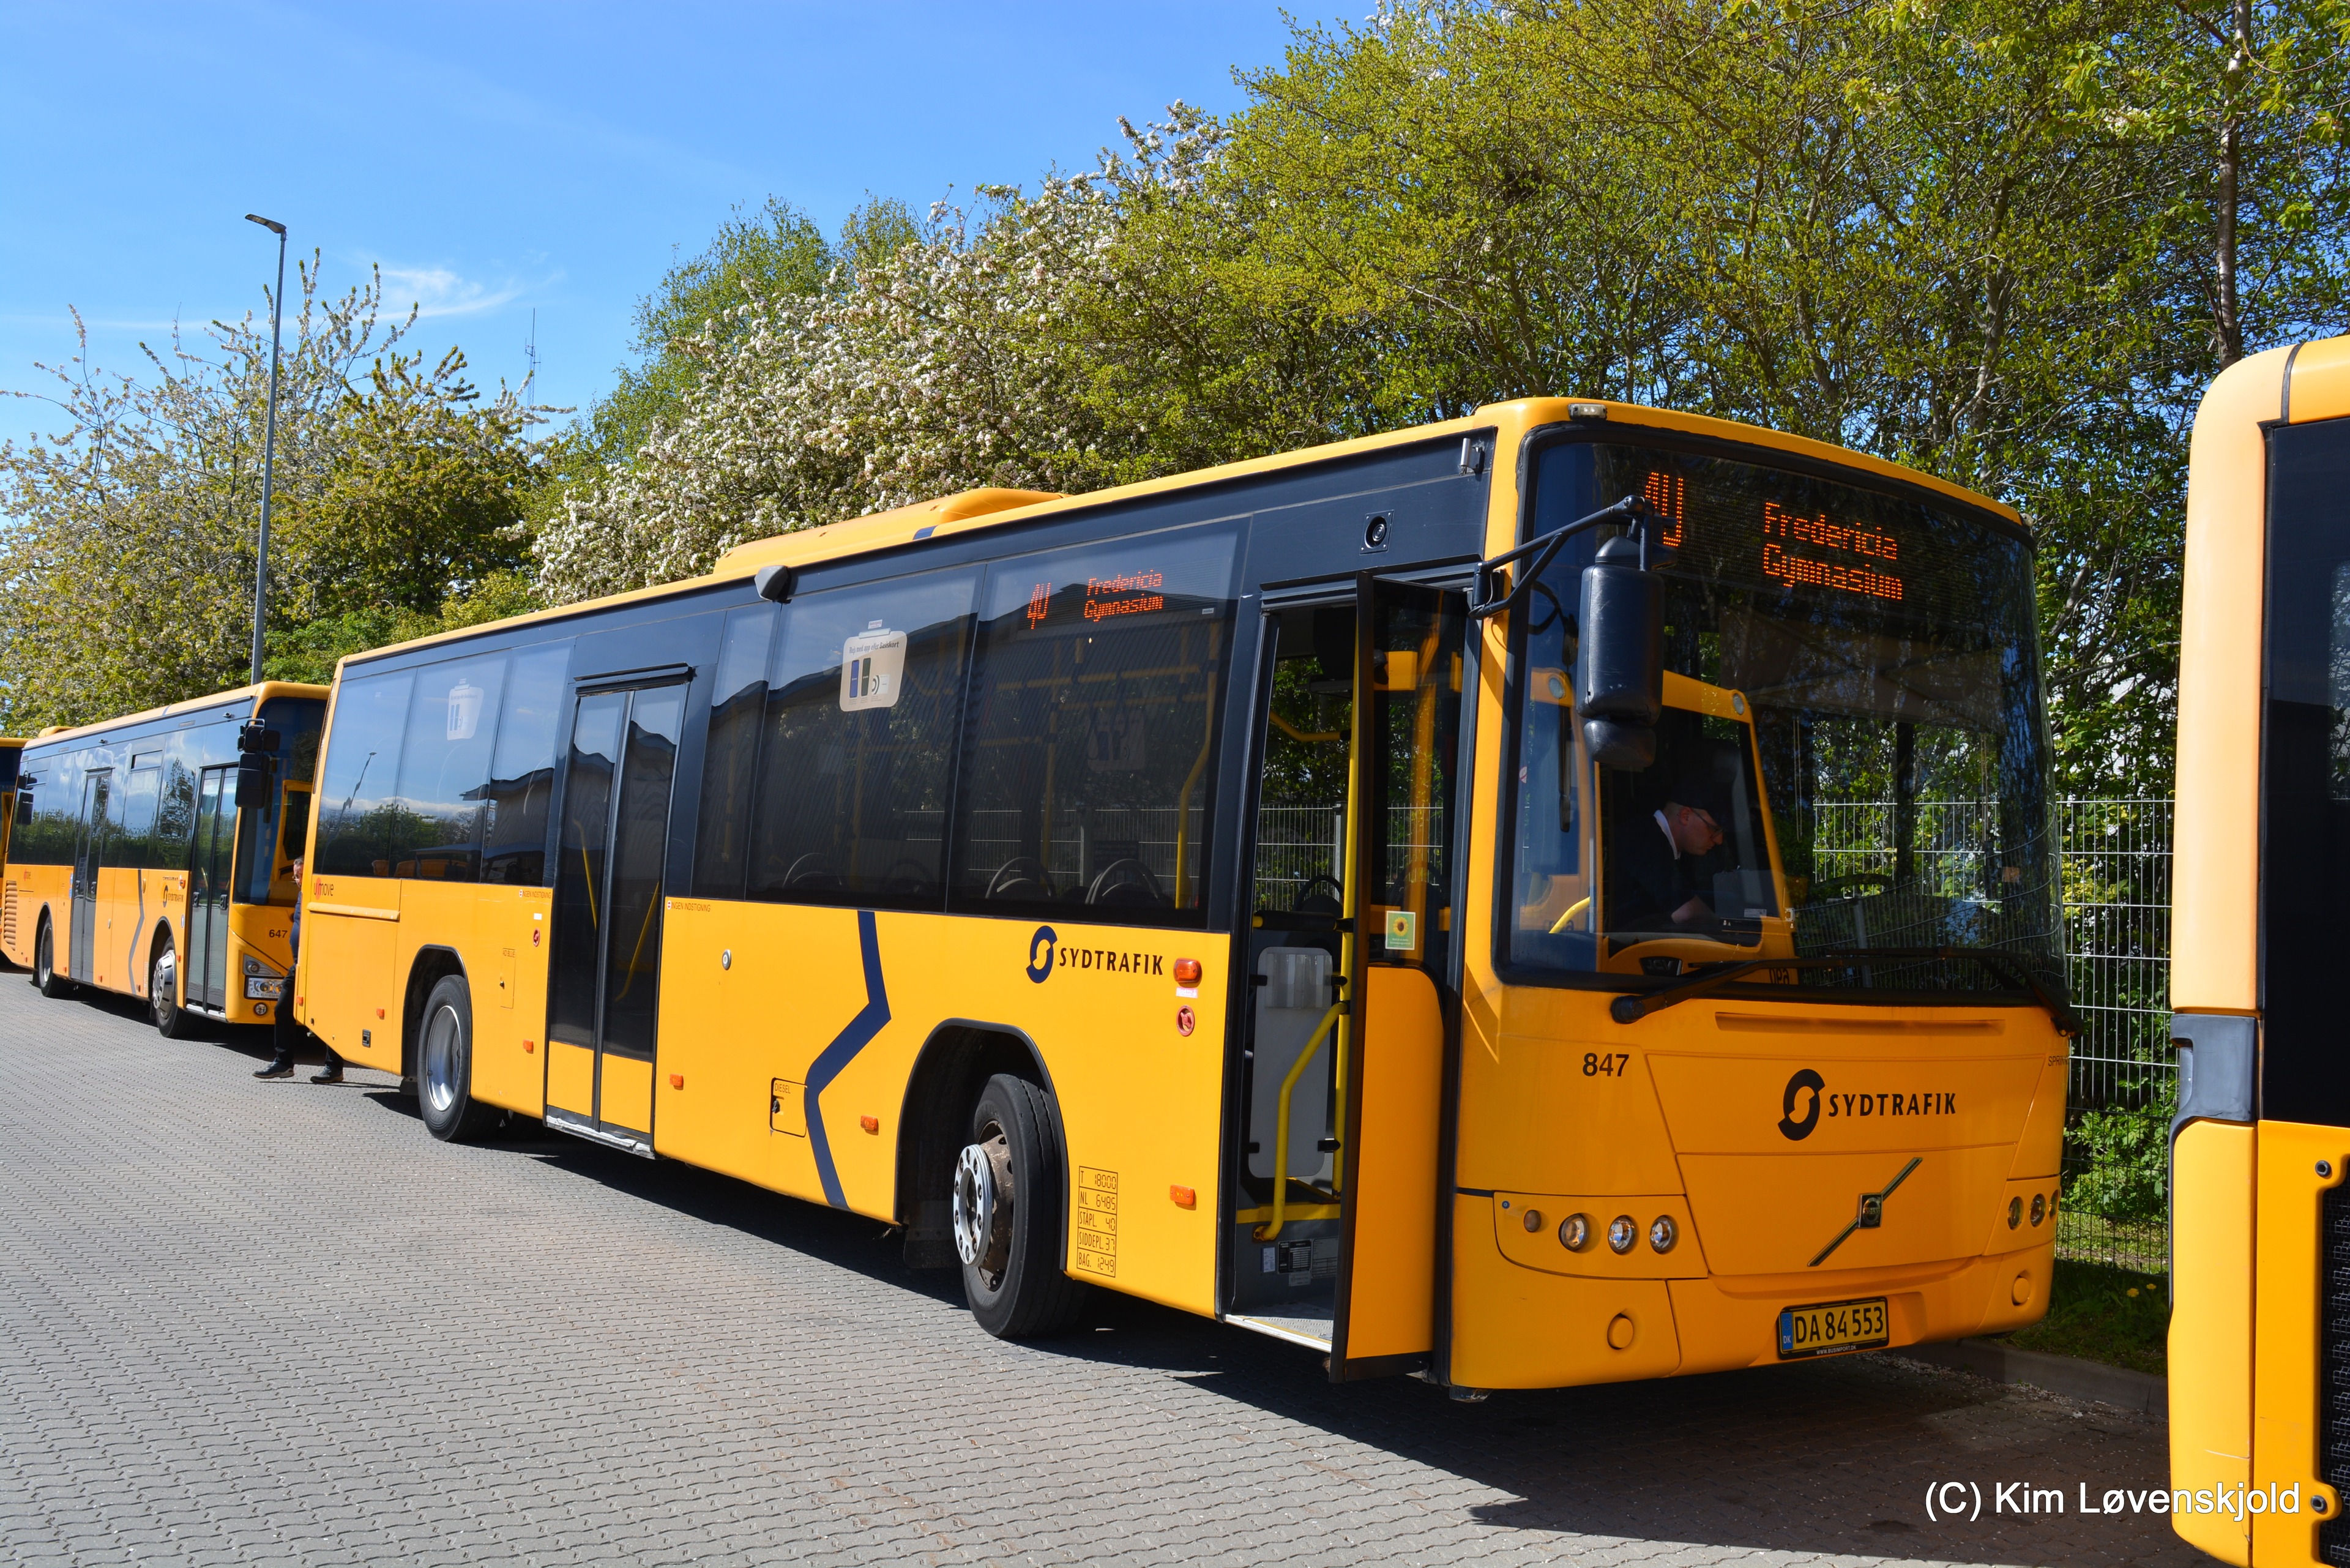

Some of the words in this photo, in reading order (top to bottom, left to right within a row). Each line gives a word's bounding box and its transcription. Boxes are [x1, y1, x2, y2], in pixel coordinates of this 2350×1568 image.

[1766, 502, 1897, 559] Fredericia
[1763, 543, 1903, 599] Gymnasium
[1087, 569, 1162, 595] Fredericia
[1027, 582, 1051, 629] 4U
[1084, 593, 1163, 622] Gymnasium
[879, 641, 899, 649] Basiskort
[671, 902, 684, 910] INGEN
[685, 903, 711, 913] INDSTIGNING
[269, 929, 288, 938] 647
[1059, 947, 1163, 976] SYDTRAFIK
[1583, 1053, 1629, 1077] 847
[775, 1083, 791, 1094] DIESEL
[1828, 1092, 1956, 1117] SYDTRAFIK
[1081, 1171, 1084, 1184] T
[1094, 1174, 1116, 1189] 18000
[1080, 1191, 1088, 1205] NL
[1096, 1195, 1116, 1210] 6485
[1080, 1210, 1097, 1227] STÅPL.
[1106, 1218, 1116, 1231] 40
[1079, 1231, 1104, 1250] SIDDEPL.
[1106, 1238, 1115, 1251] 37
[1078, 1252, 1091, 1267] BAG.
[1097, 1257, 1114, 1272] 1249
[1794, 1315, 1821, 1344] DA
[1825, 1310, 1848, 1340] 84
[1852, 1306, 1883, 1337] 553
[1783, 1335, 1791, 1344] DK
[1816, 1345, 1857, 1355] WWW.BUSIMPORT.DK
